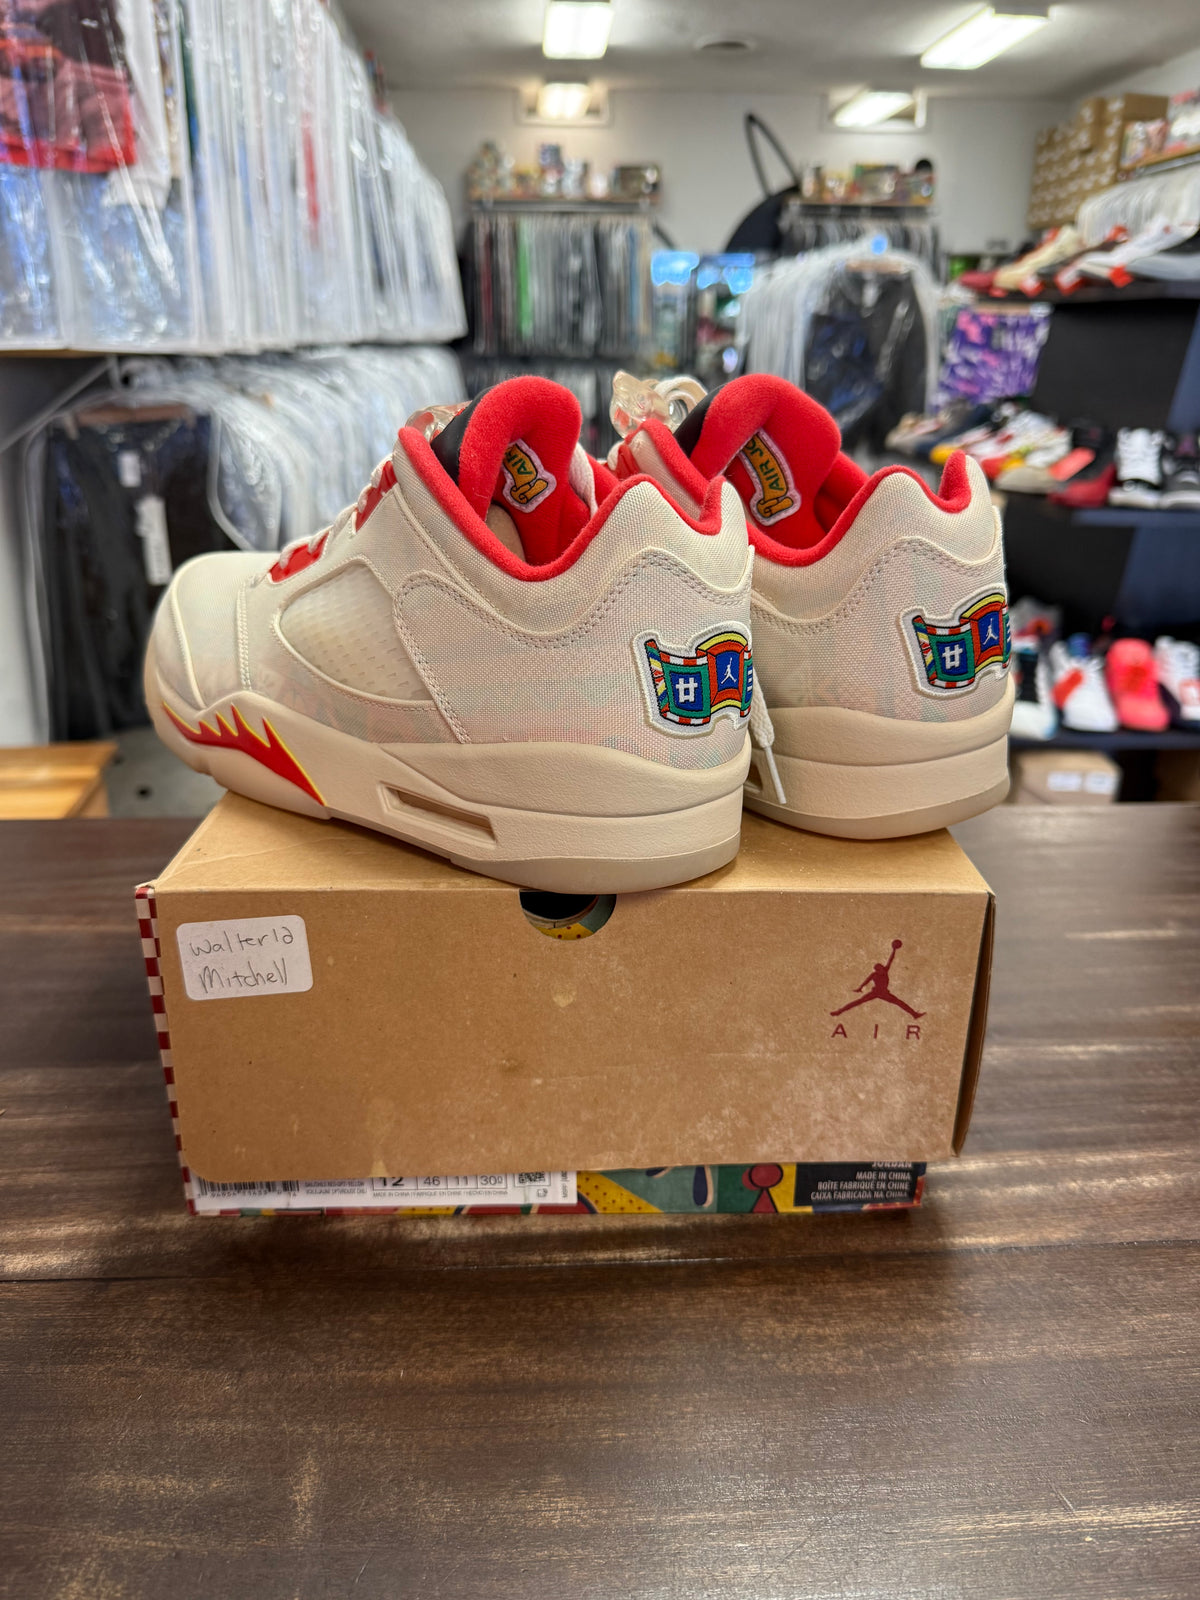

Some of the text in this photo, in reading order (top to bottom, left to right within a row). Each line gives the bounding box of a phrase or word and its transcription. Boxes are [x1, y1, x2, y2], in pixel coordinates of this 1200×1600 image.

[759, 459, 784, 491] AIR
[198, 957, 288, 994] Mitchell
[831, 1023, 921, 1040] AIR
[423, 1175, 441, 1186] 46
[856, 1171, 911, 1181] MADE IN CHINA
[876, 1181, 886, 1190] EN
[887, 1181, 910, 1190] CHINE
[811, 1191, 832, 1200] CAIXA
[833, 1190, 872, 1200] FABRICADA
[873, 1190, 884, 1199] NA
